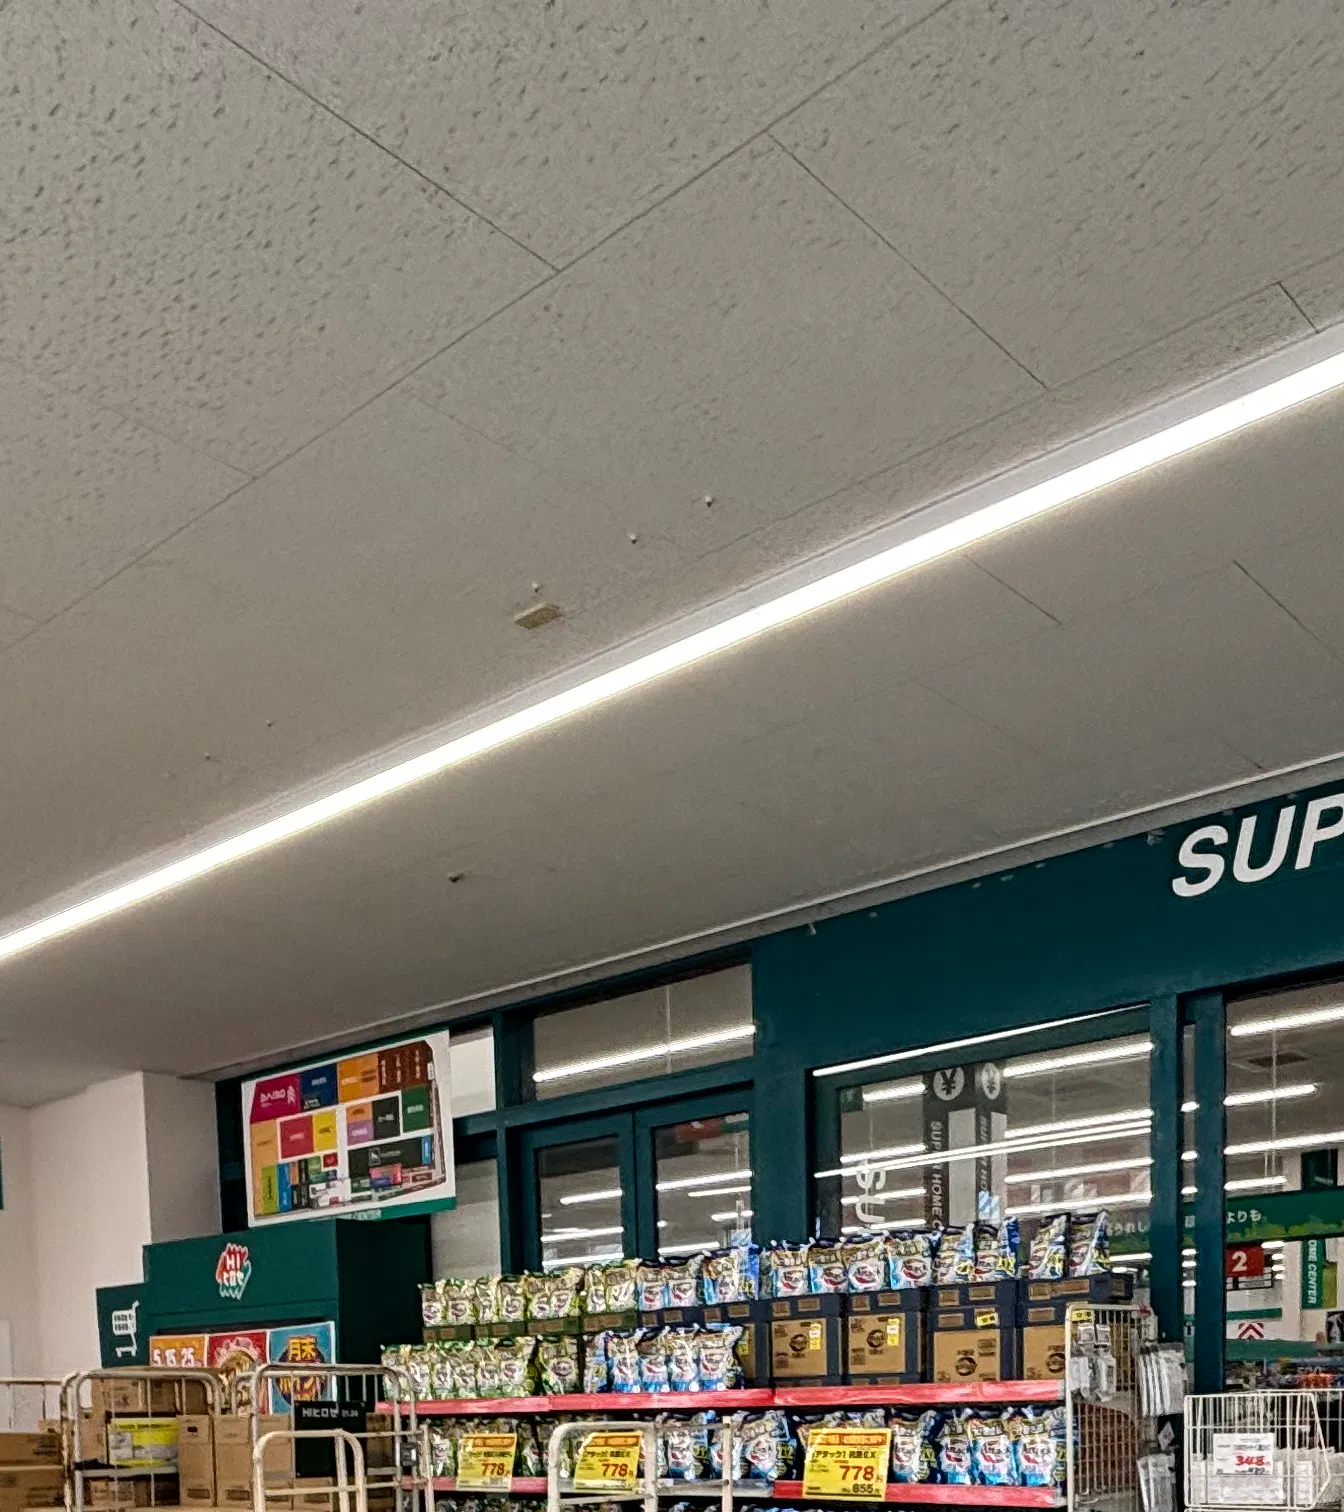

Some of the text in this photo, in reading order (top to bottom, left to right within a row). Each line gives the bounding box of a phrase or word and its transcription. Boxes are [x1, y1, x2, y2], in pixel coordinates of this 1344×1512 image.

[225, 1253, 242, 1270] HI
[1230, 1251, 1248, 1273] 2
[601, 1463, 629, 1478] 778
[839, 1464, 875, 1482] 778
